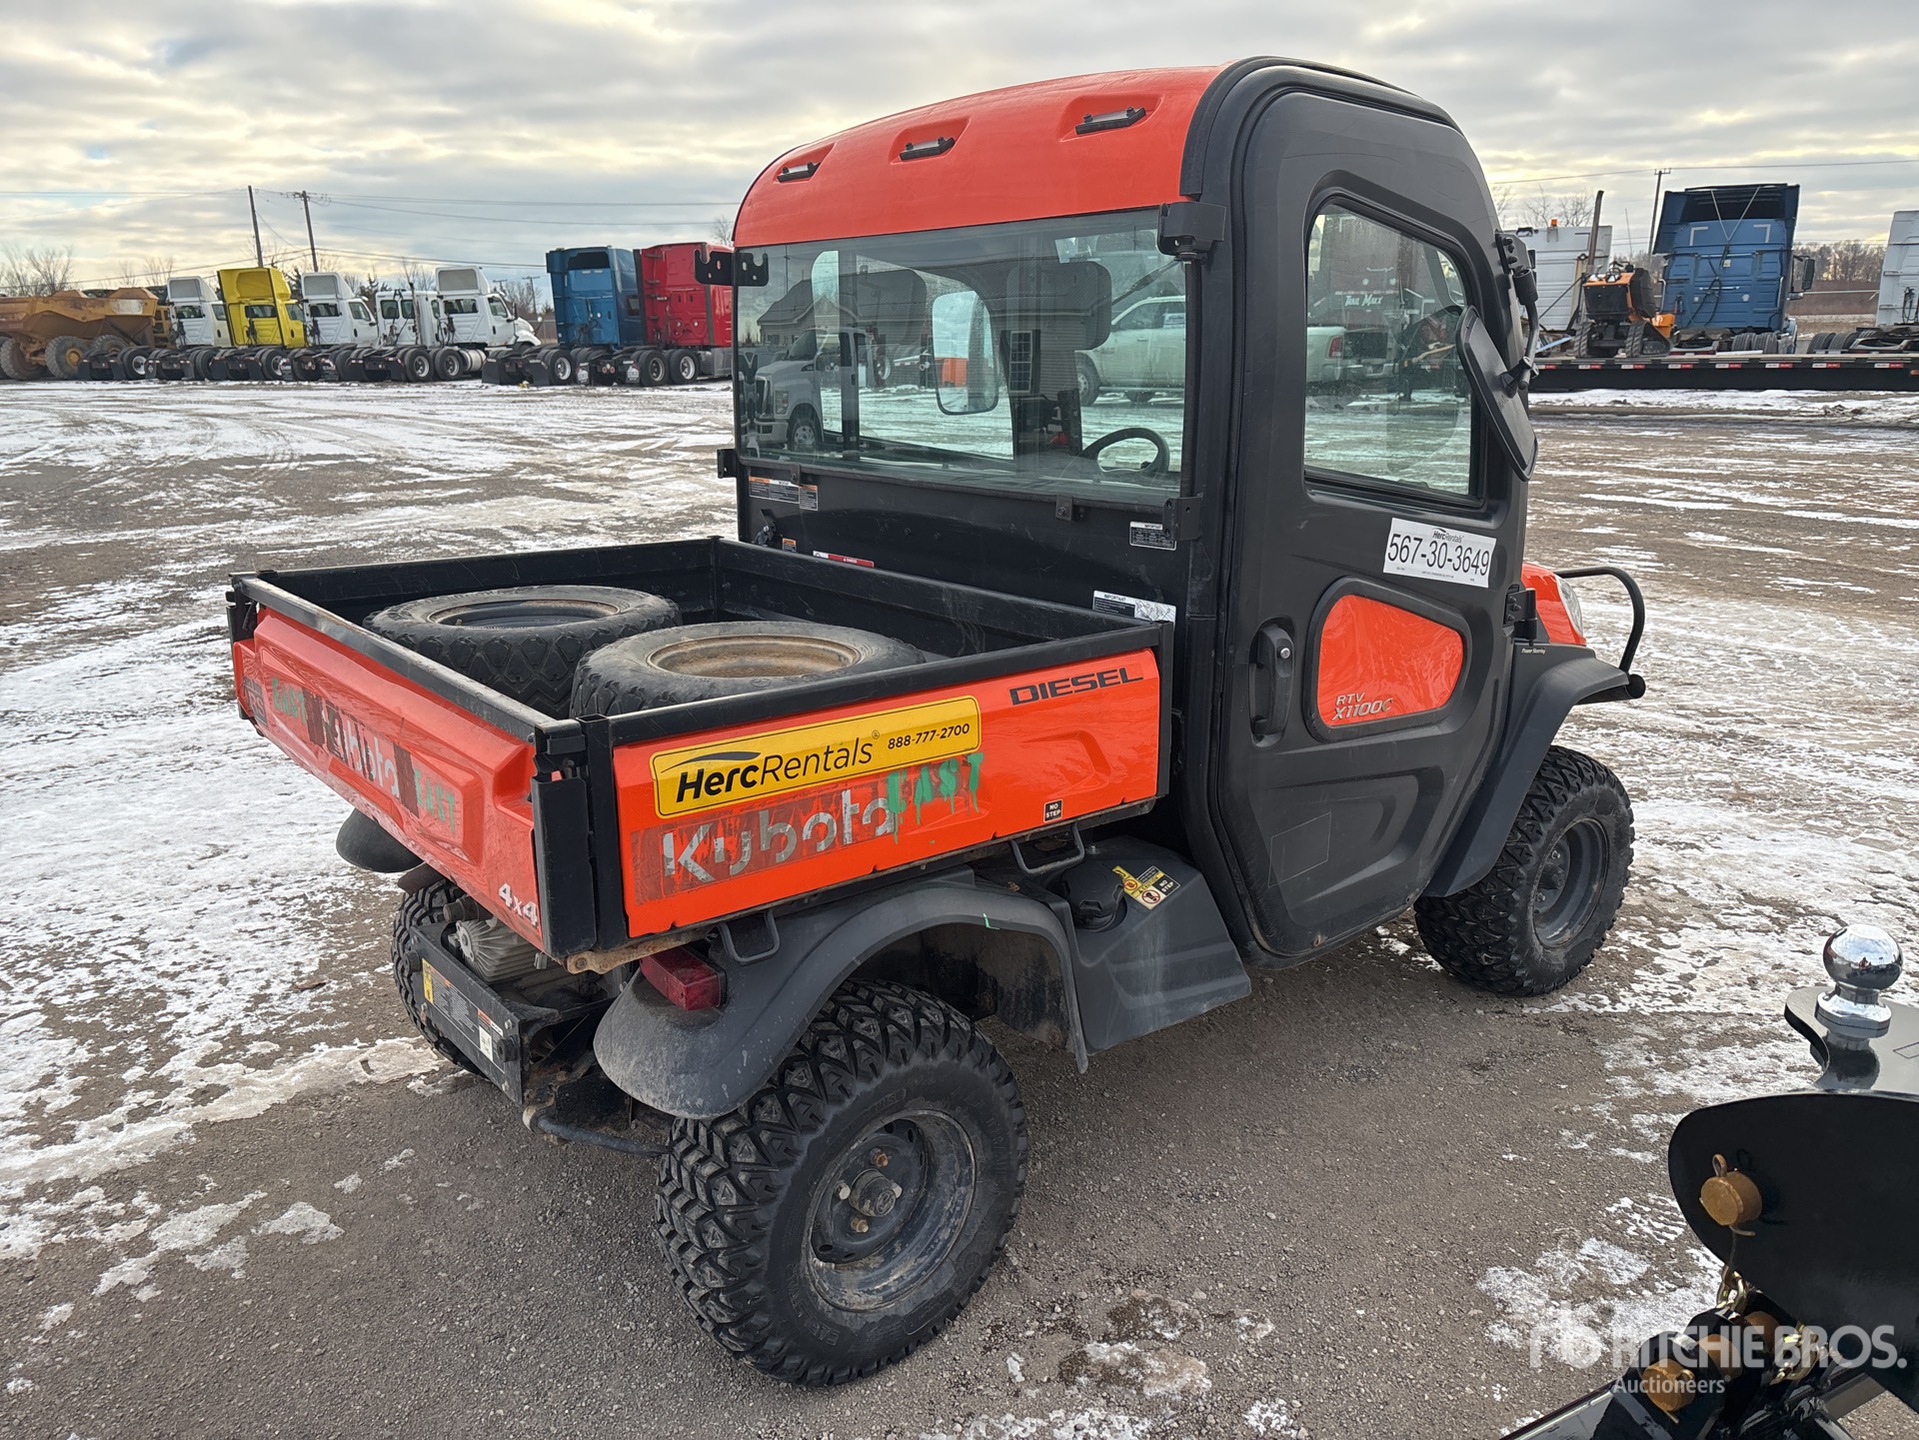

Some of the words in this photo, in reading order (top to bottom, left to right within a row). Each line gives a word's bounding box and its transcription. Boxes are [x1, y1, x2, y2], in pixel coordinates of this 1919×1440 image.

[1387, 533, 1490, 576] 567-30-3649
[1009, 667, 1144, 706] DIESEL
[1335, 691, 1366, 706] RTV
[1331, 697, 1394, 721] X1100C
[887, 723, 970, 750] 888-777-2700
[414, 767, 456, 833] EAST
[886, 752, 985, 824] EAST
[1045, 809, 1061, 819] STEP
[1049, 802, 1059, 810] NO
[498, 883, 538, 928] 4x4
